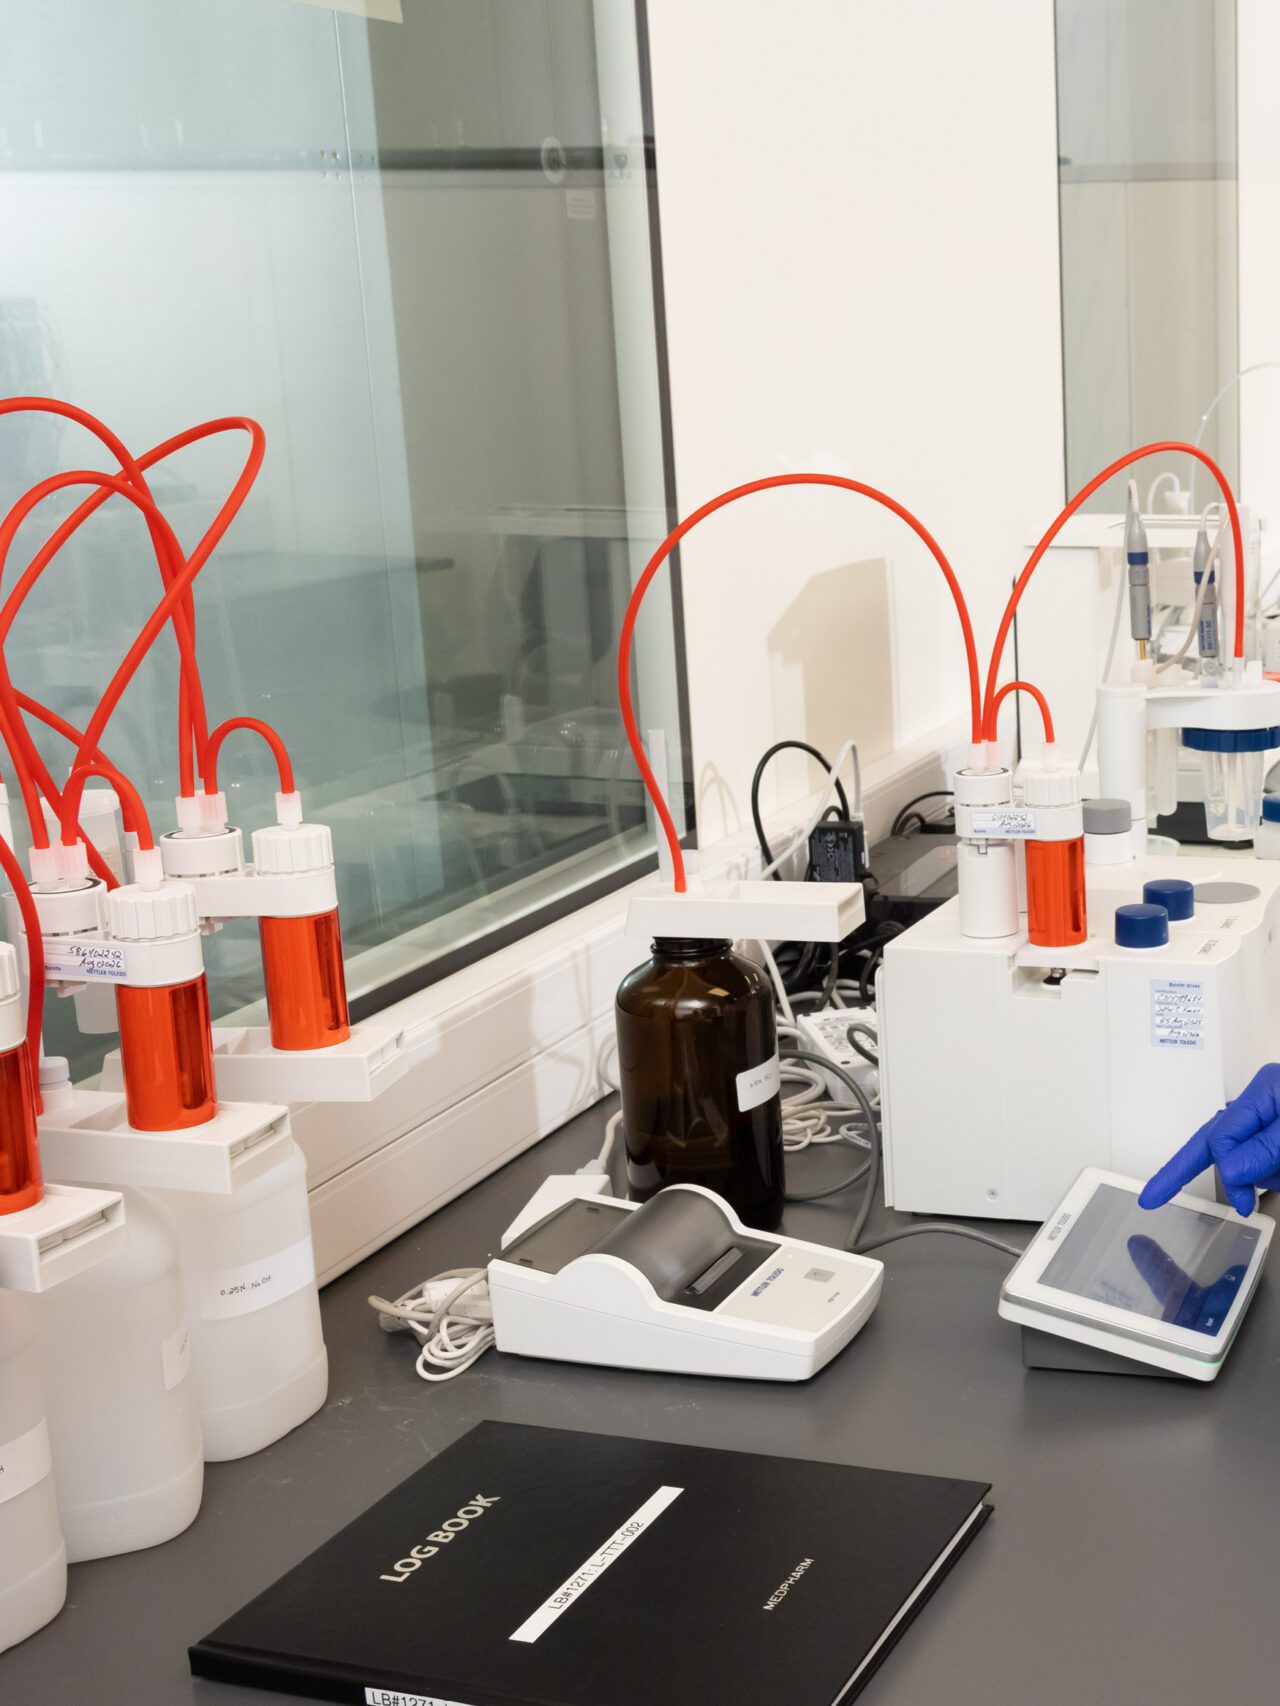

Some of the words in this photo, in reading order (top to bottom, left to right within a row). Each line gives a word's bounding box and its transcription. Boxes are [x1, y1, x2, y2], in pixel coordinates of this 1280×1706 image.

[79, 958, 94, 969] Aug
[751, 1281, 771, 1297] METTLER
[766, 1267, 784, 1281] TOLEDO
[379, 1545, 440, 1582] LOG
[426, 1493, 501, 1543] BOOK
[547, 1569, 599, 1611] LB#1271:
[590, 1521, 645, 1569] L-TTT-002
[763, 1557, 815, 1611] MEDPHARM
